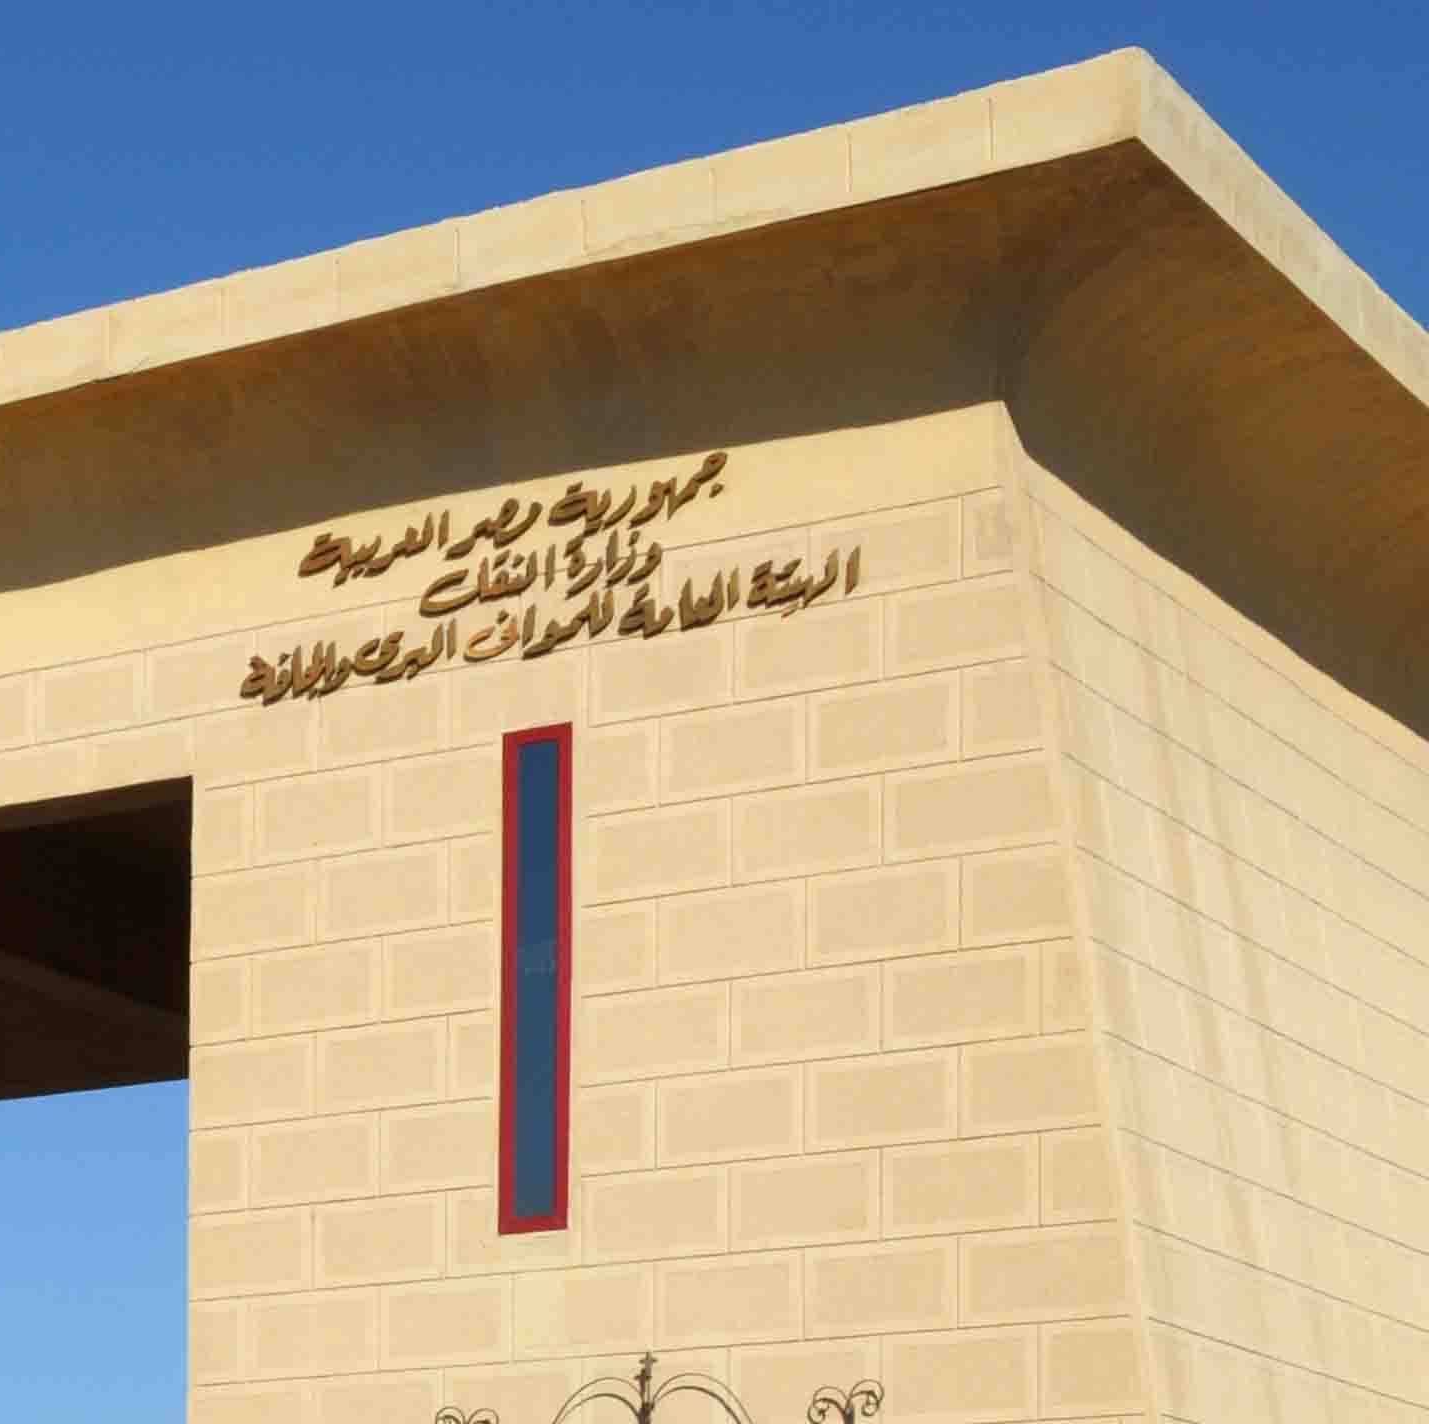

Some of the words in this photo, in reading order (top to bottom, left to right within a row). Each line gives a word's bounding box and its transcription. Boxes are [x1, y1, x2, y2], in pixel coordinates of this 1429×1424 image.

[444, 497, 544, 561] مصر
[549, 451, 728, 536] جمهورية
[298, 509, 450, 589] العربية
[419, 542, 557, 619] النقل
[563, 528, 662, 601] وزارة
[746, 544, 861, 619] الهيئة
[616, 563, 741, 641] العامة
